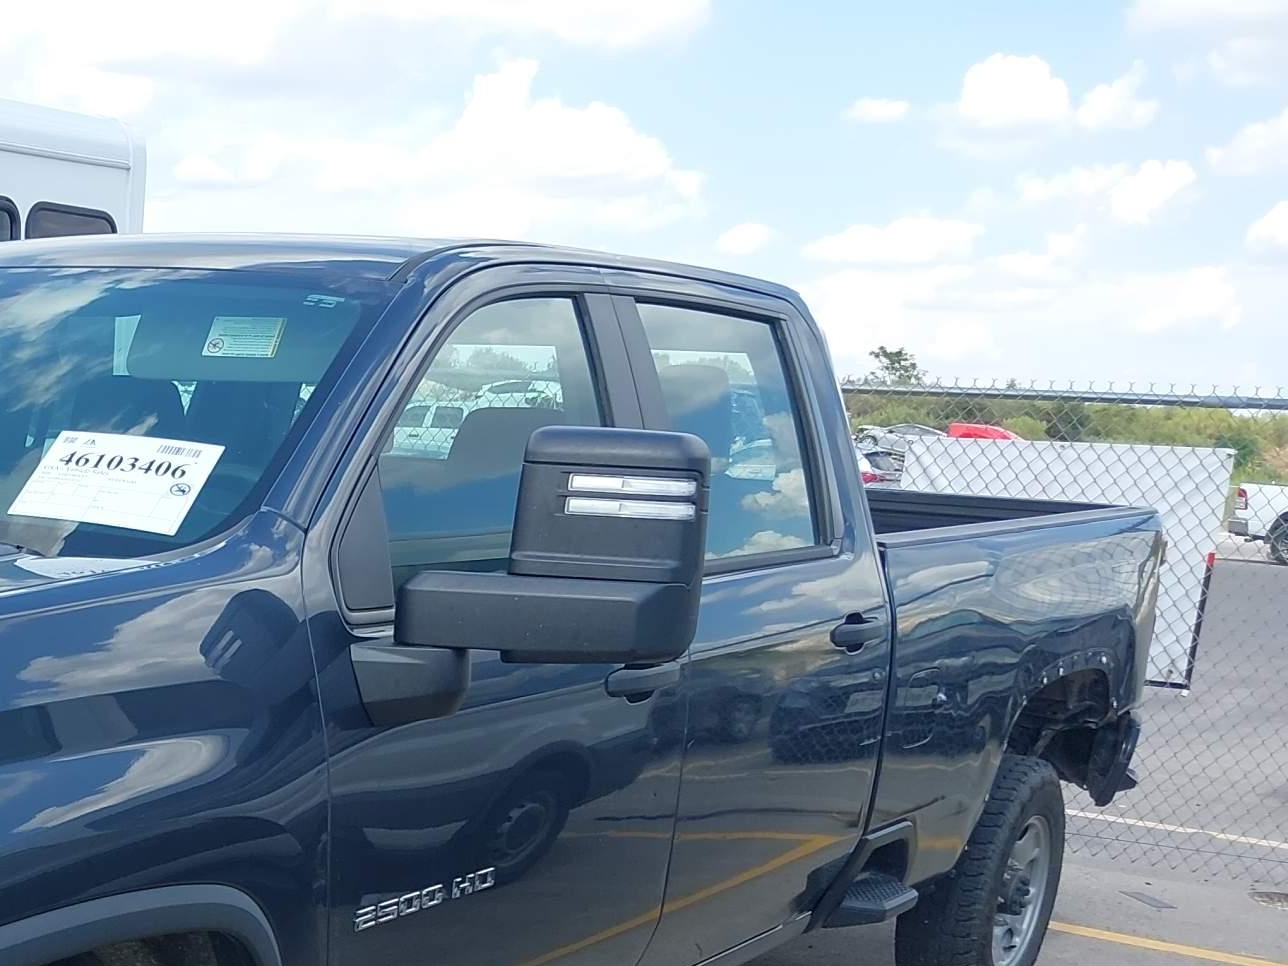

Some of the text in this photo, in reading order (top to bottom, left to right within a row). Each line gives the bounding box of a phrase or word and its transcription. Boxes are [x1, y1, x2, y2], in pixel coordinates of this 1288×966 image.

[59, 450, 187, 480] 46103406
[353, 866, 496, 933] 2500 HD
